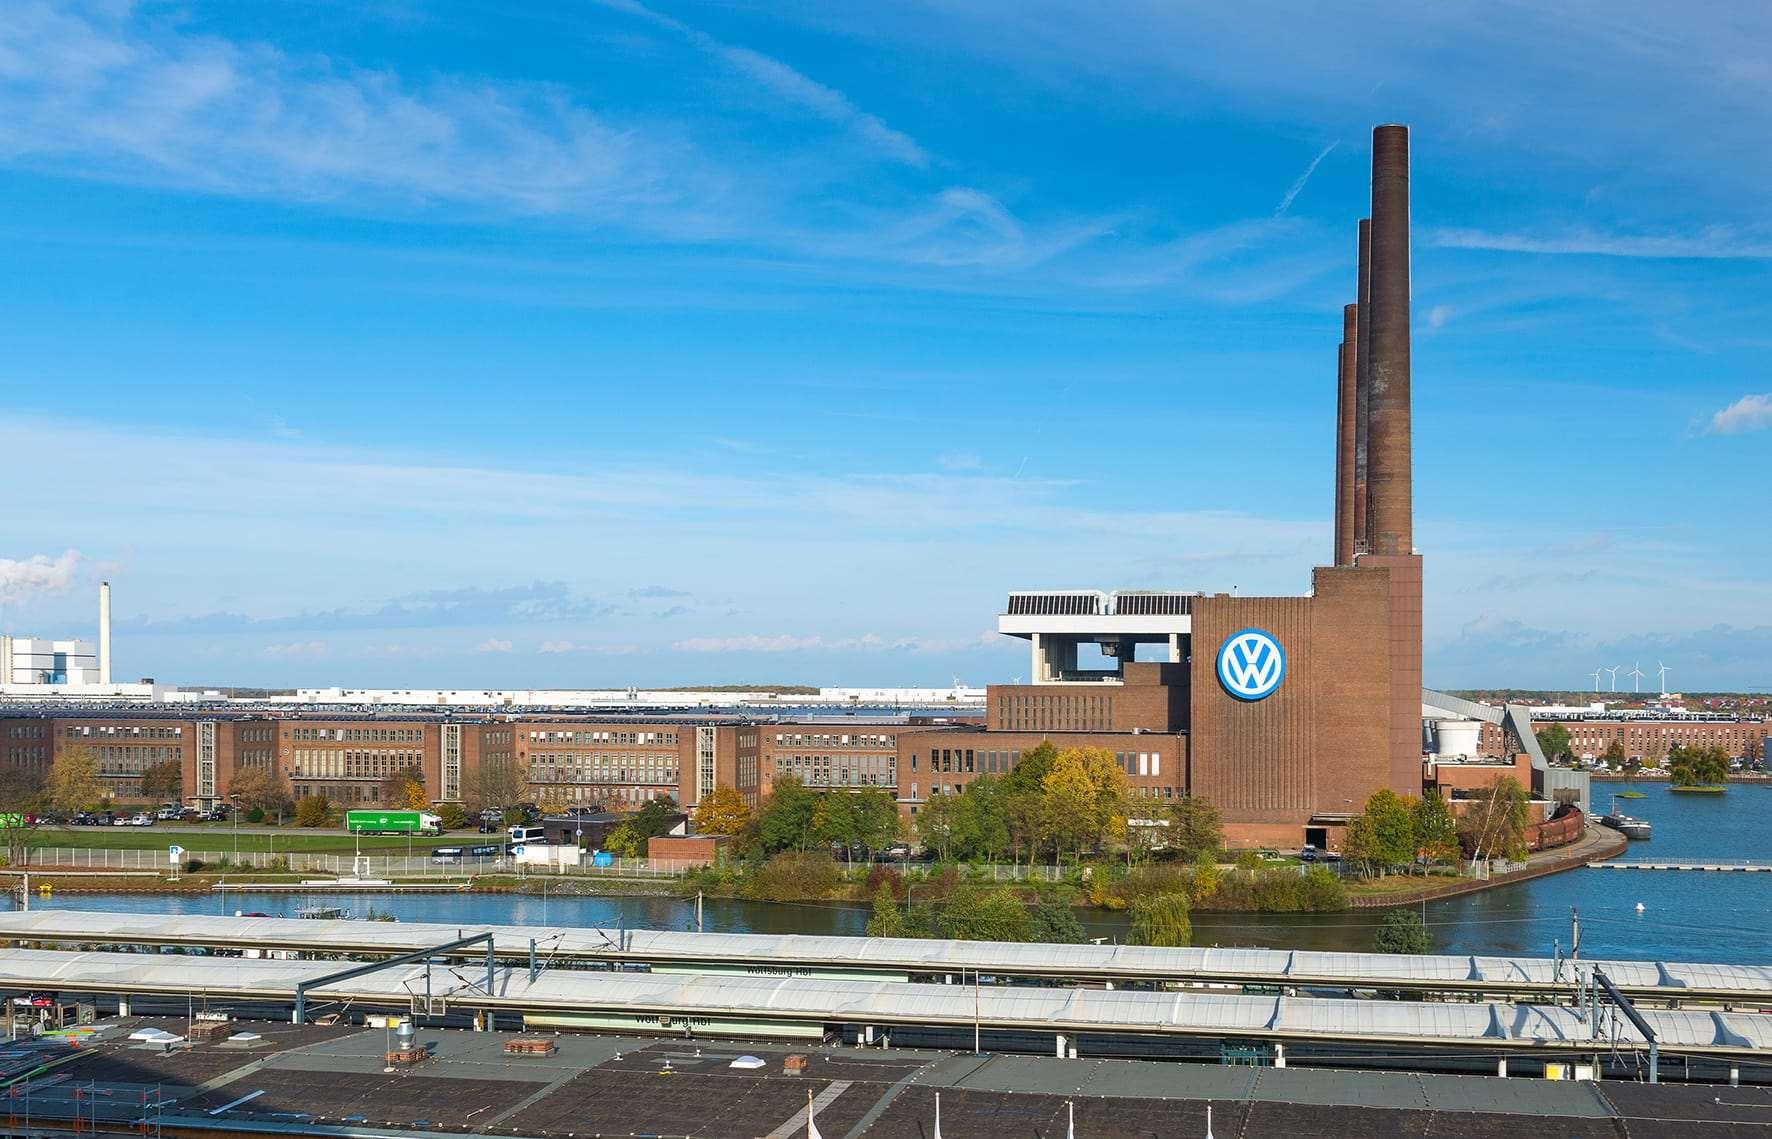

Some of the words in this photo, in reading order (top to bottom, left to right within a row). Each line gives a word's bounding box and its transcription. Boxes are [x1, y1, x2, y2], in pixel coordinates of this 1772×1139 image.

[1222, 634, 1281, 694] VW
[747, 966, 792, 977] Wolfsburg
[635, 1015, 688, 1027] Wolfurg
